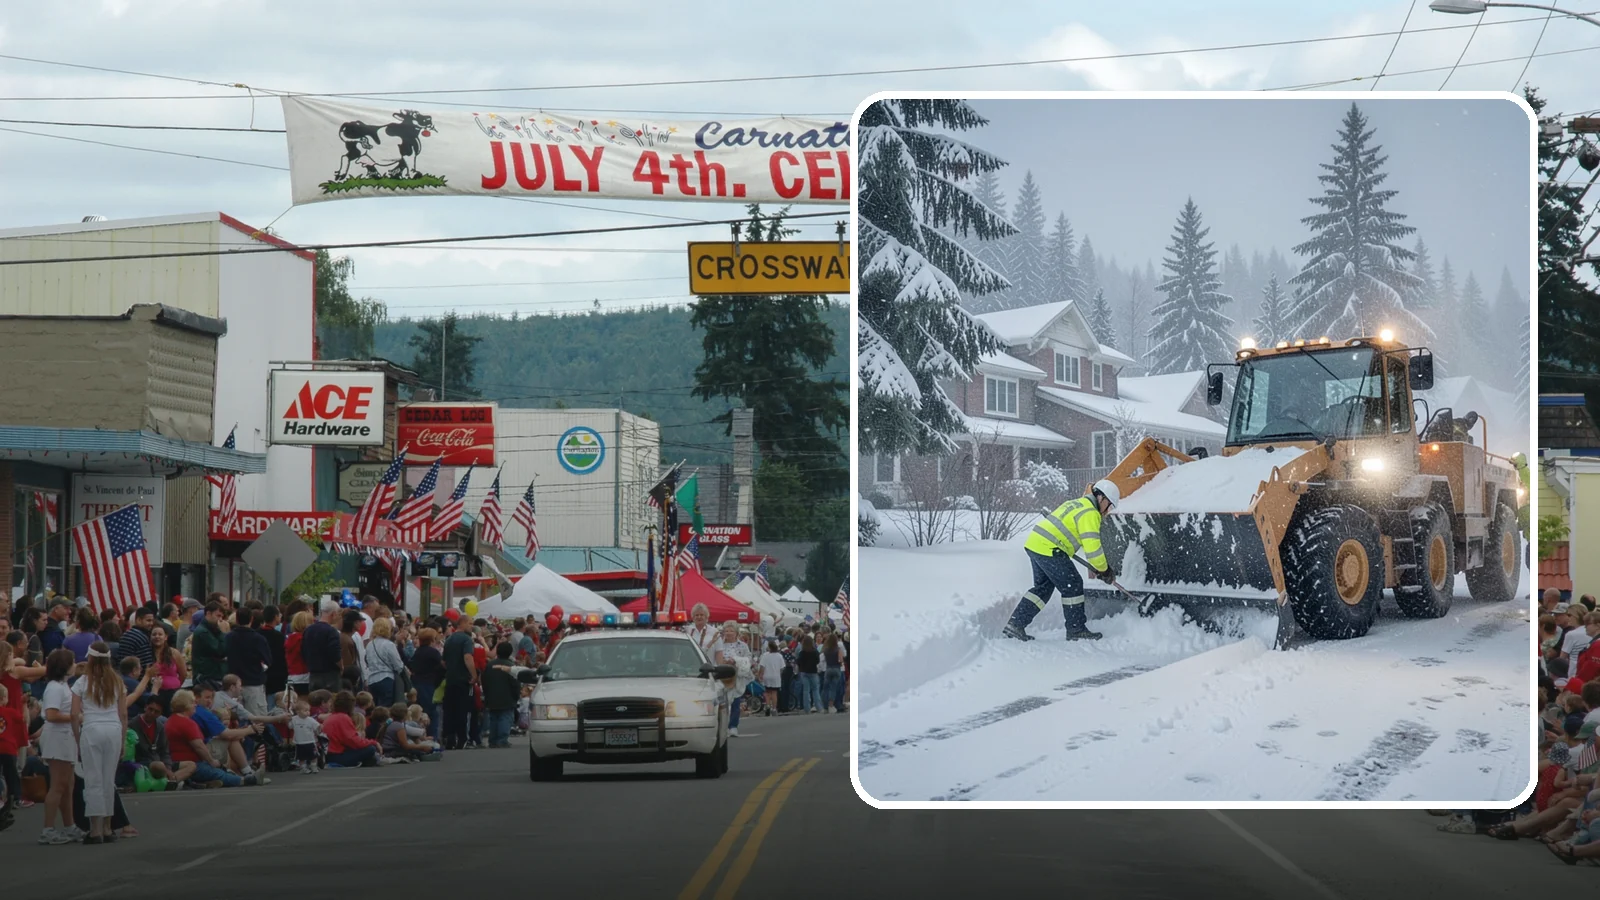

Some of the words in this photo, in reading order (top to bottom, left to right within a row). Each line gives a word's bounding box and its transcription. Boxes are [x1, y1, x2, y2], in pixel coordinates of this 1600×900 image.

[481, 140, 605, 193] JULY
[632, 150, 746, 198] 4th.
[697, 254, 850, 280] CROSSWA
[283, 380, 373, 420] ACE
[405, 409, 453, 421] CEDAR
[461, 409, 485, 421] LOG
[283, 421, 370, 436] Hardware
[353, 467, 386, 480] Simpl
[83, 485, 93, 494] St.
[96, 485, 124, 495] Vincent
[126, 486, 136, 495] de
[138, 486, 155, 495] Paul
[688, 526, 741, 535] CRNATION
[699, 535, 730, 543] GLASS
